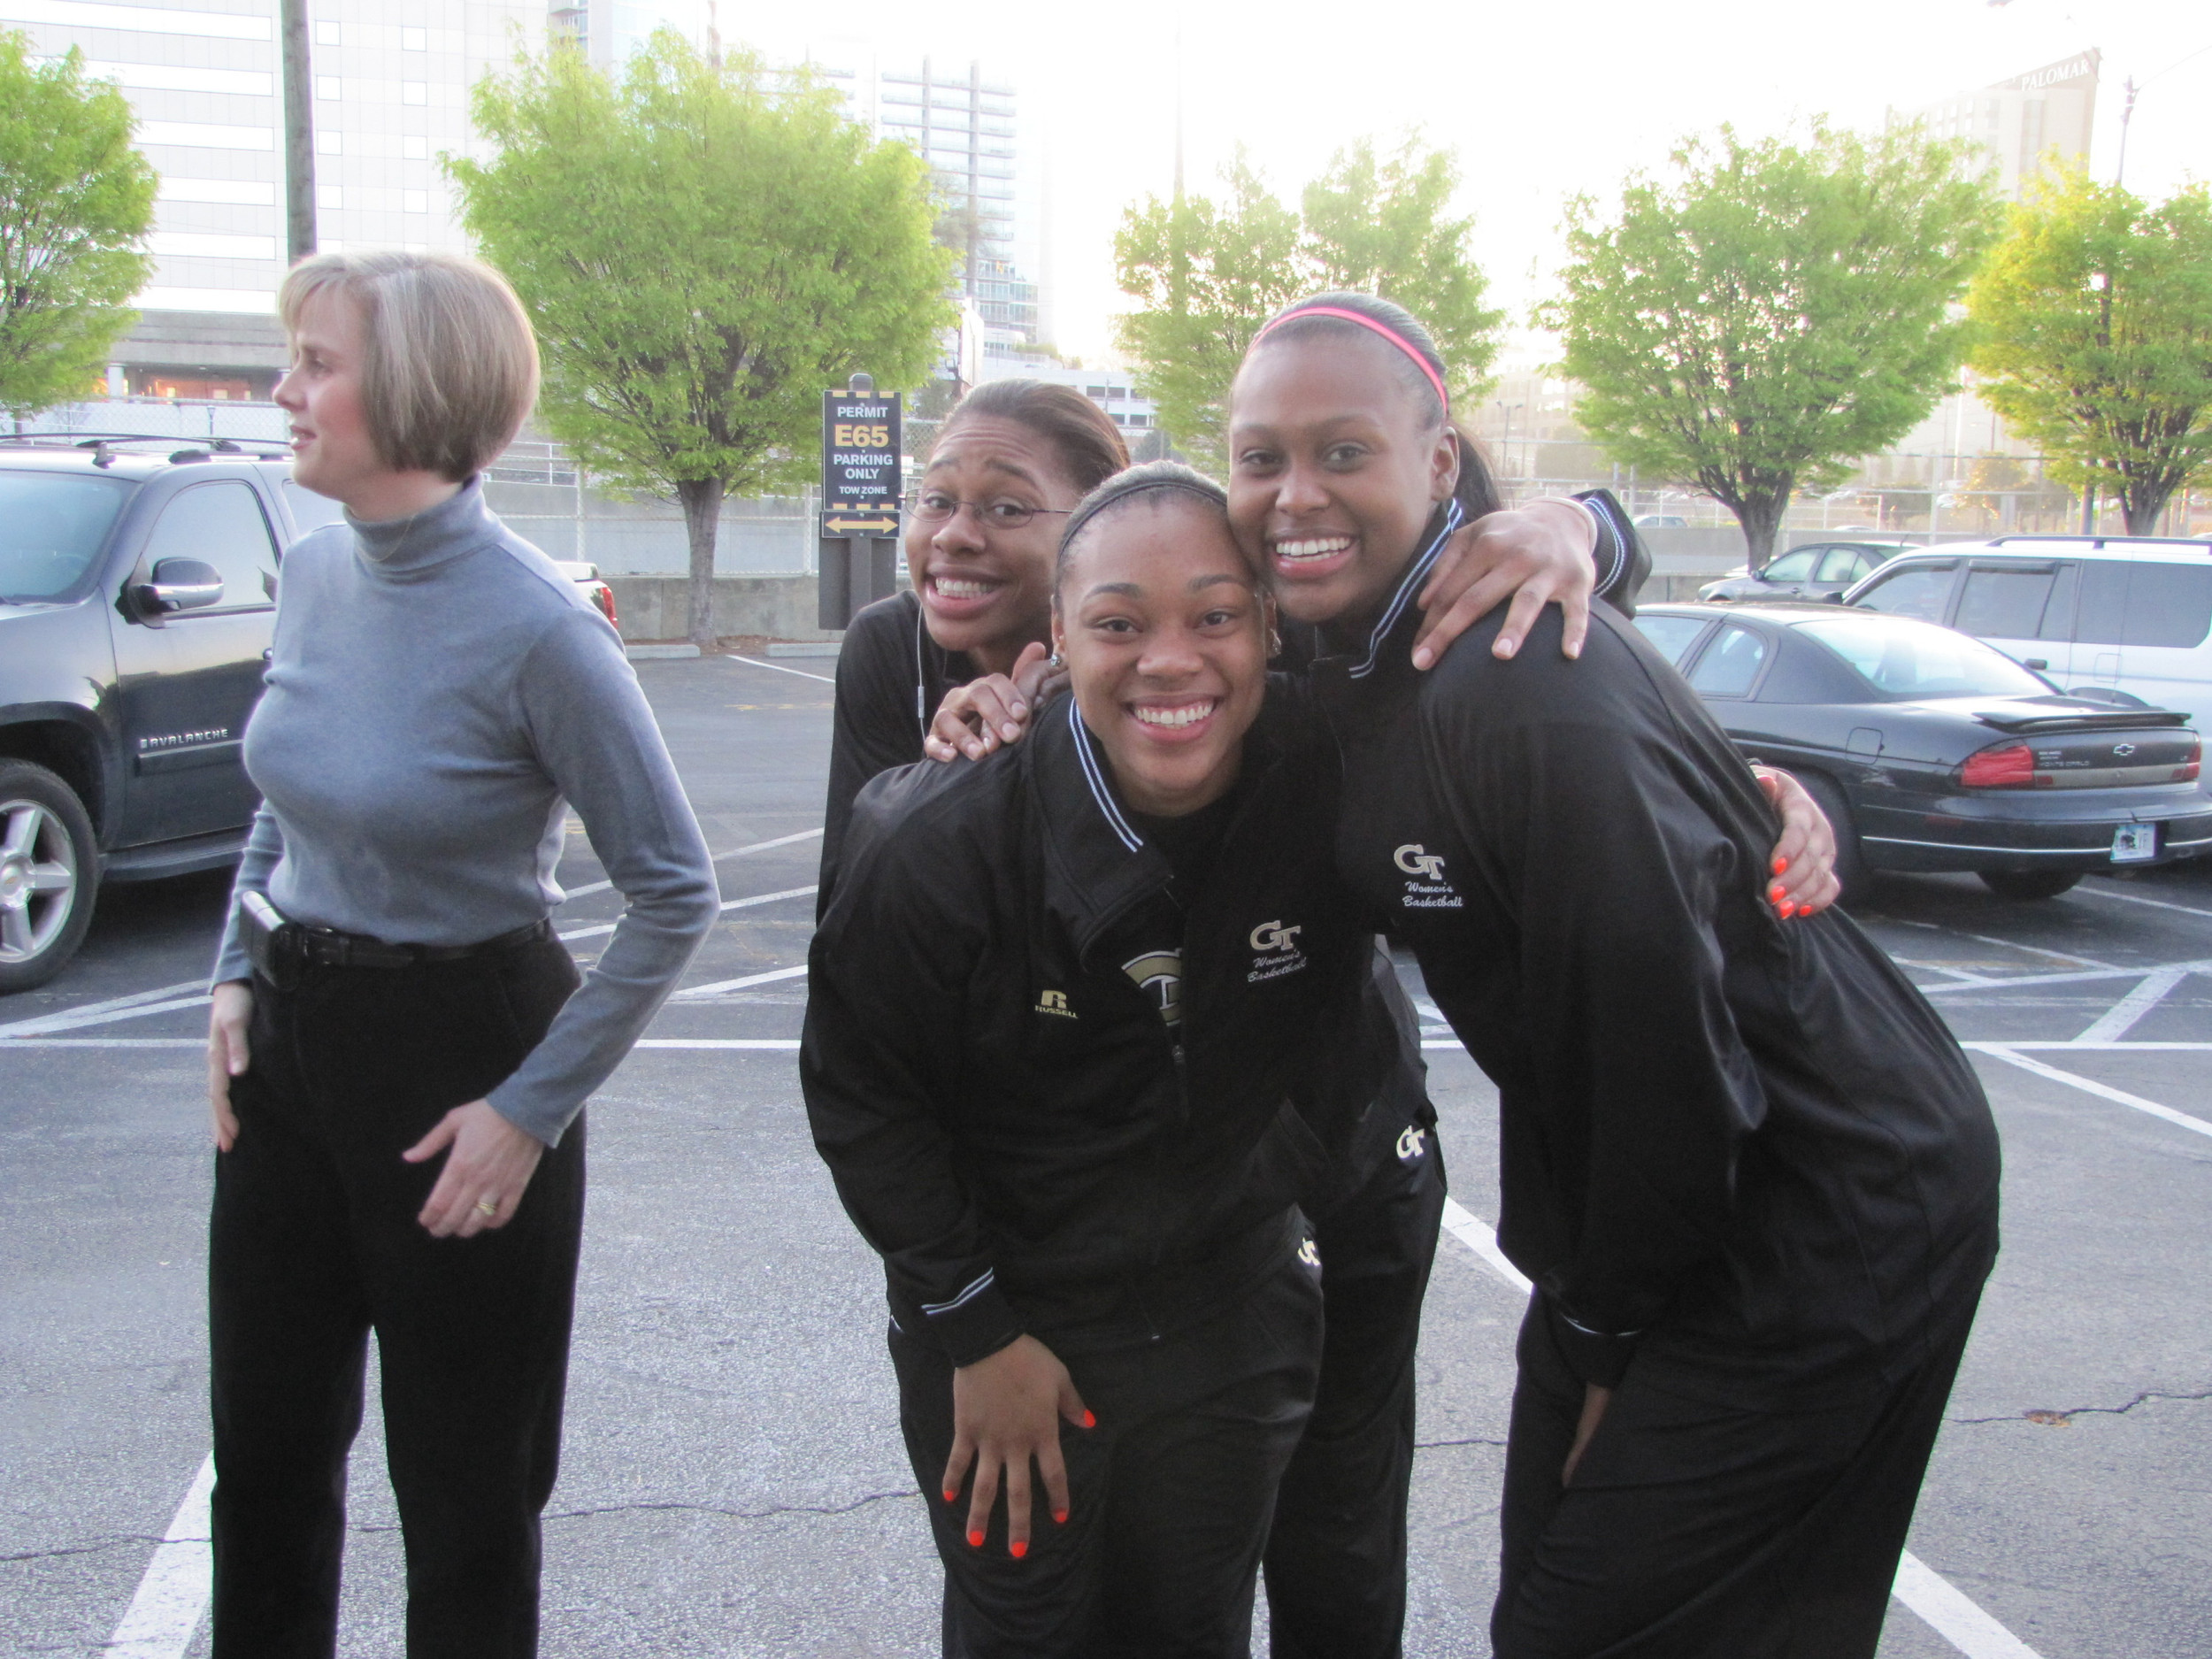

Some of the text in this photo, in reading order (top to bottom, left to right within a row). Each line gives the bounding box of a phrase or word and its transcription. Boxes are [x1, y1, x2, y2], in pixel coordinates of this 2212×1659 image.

[2021, 58, 2089, 91] PALOMAR
[837, 406, 888, 418] PERMIT
[834, 424, 889, 448] E65
[833, 454, 894, 465] PARKING
[845, 468, 879, 480] ONLY
[150, 728, 228, 748] AVALANCHE
[1394, 843, 1445, 880] GT
[1404, 880, 1454, 894] Women's
[1402, 895, 1463, 908] Basketball
[1249, 919, 1302, 951] GT
[1253, 948, 1301, 968] Women's
[1247, 956, 1307, 983] Basketball
[1034, 1004, 1079, 1019] RUSSELL
